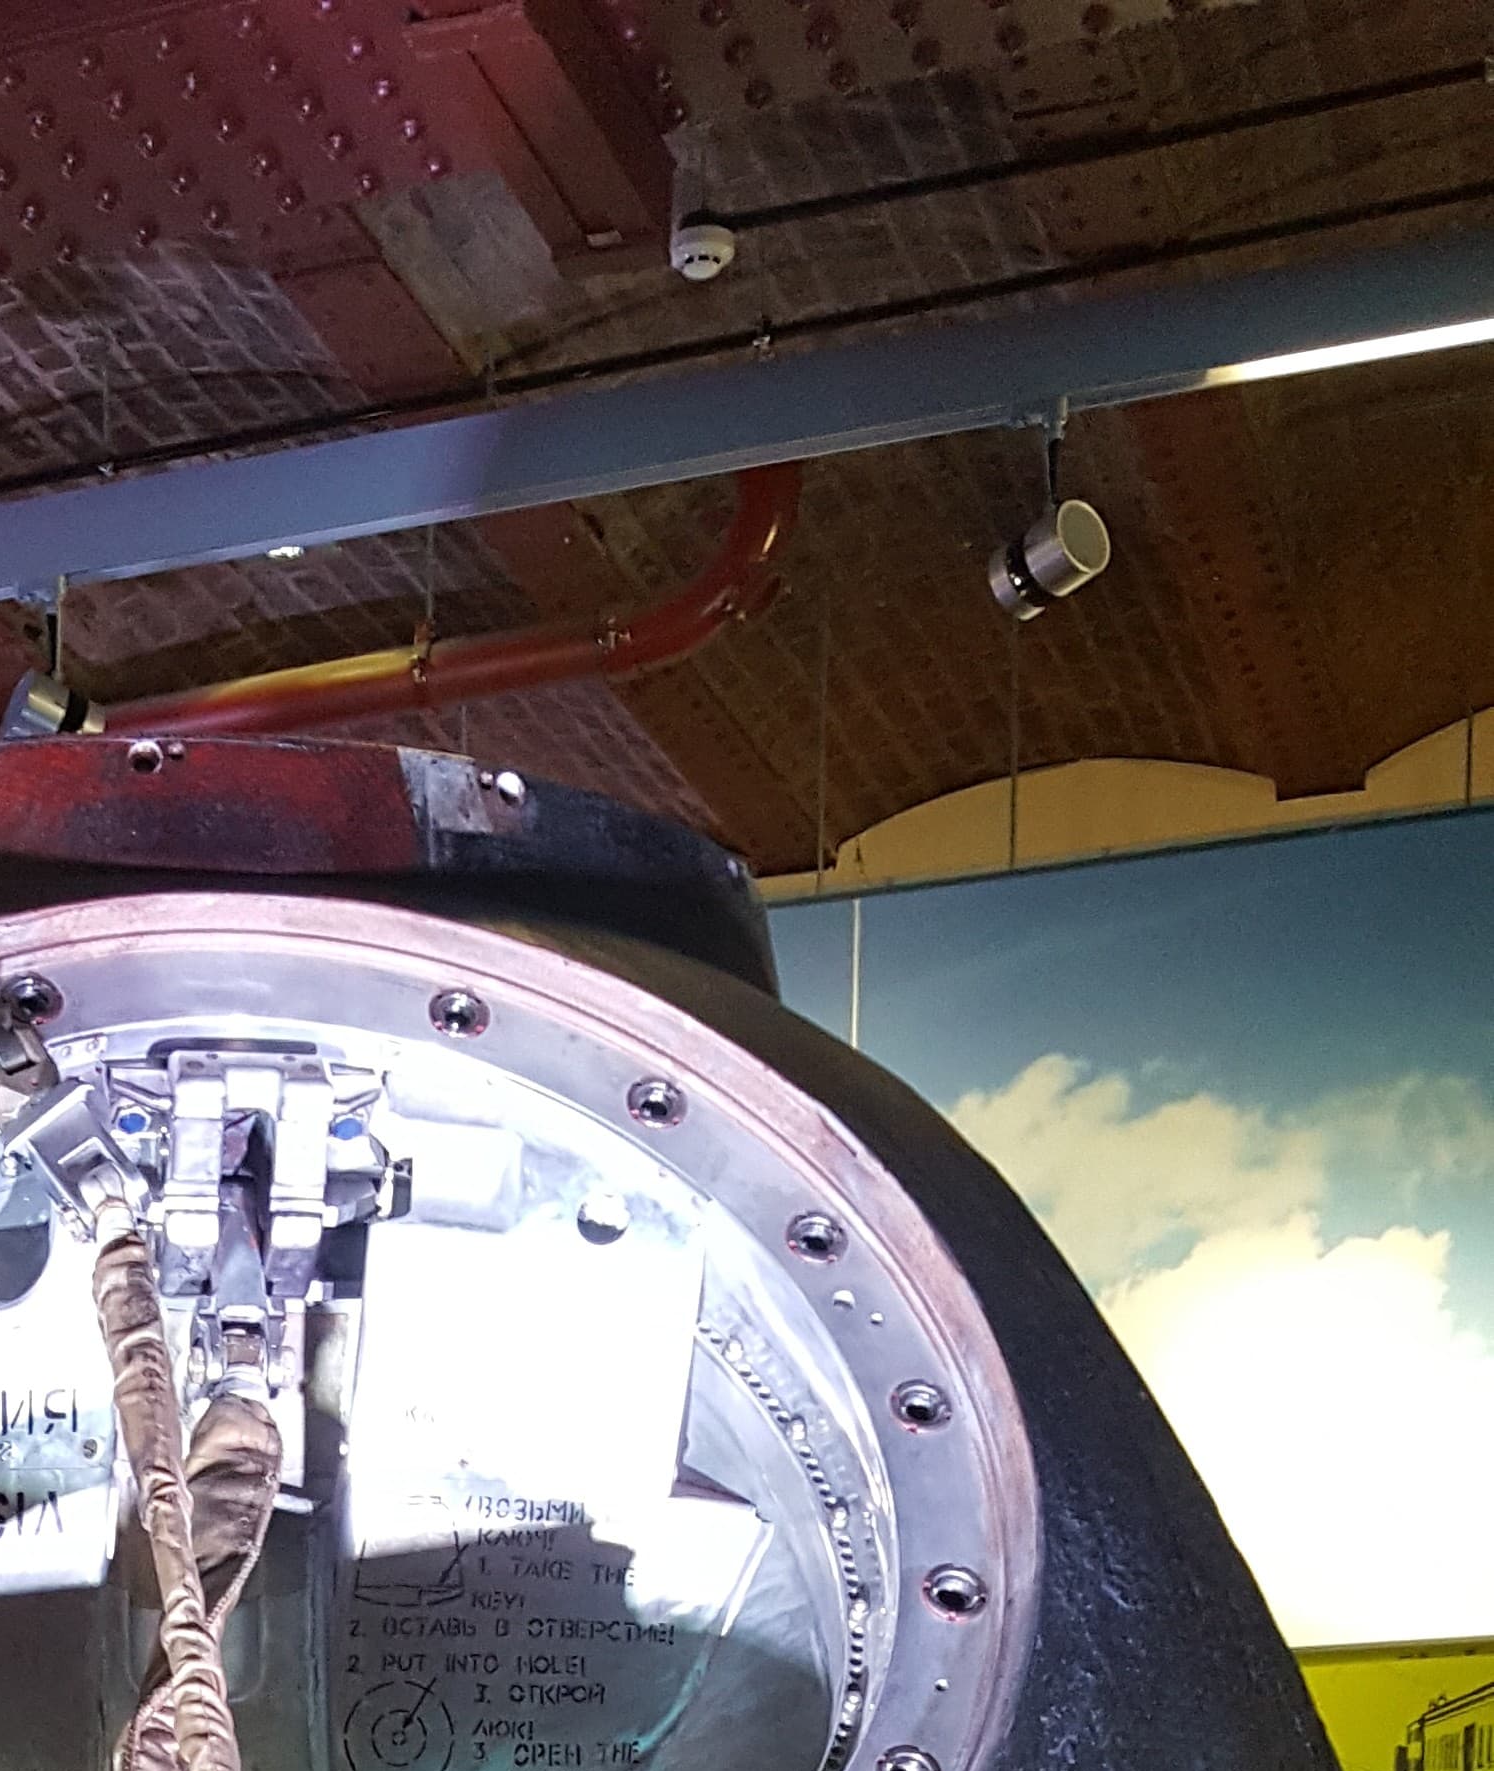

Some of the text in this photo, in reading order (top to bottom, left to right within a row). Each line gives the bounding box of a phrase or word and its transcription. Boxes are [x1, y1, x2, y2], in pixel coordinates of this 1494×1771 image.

[511, 1555, 574, 1581] TAKE
[591, 1563, 635, 1587] THE
[381, 1652, 426, 1673] PUT
[445, 1652, 499, 1674] INTO
[514, 1742, 582, 1768] OPEN
[596, 1741, 642, 1765] THE
